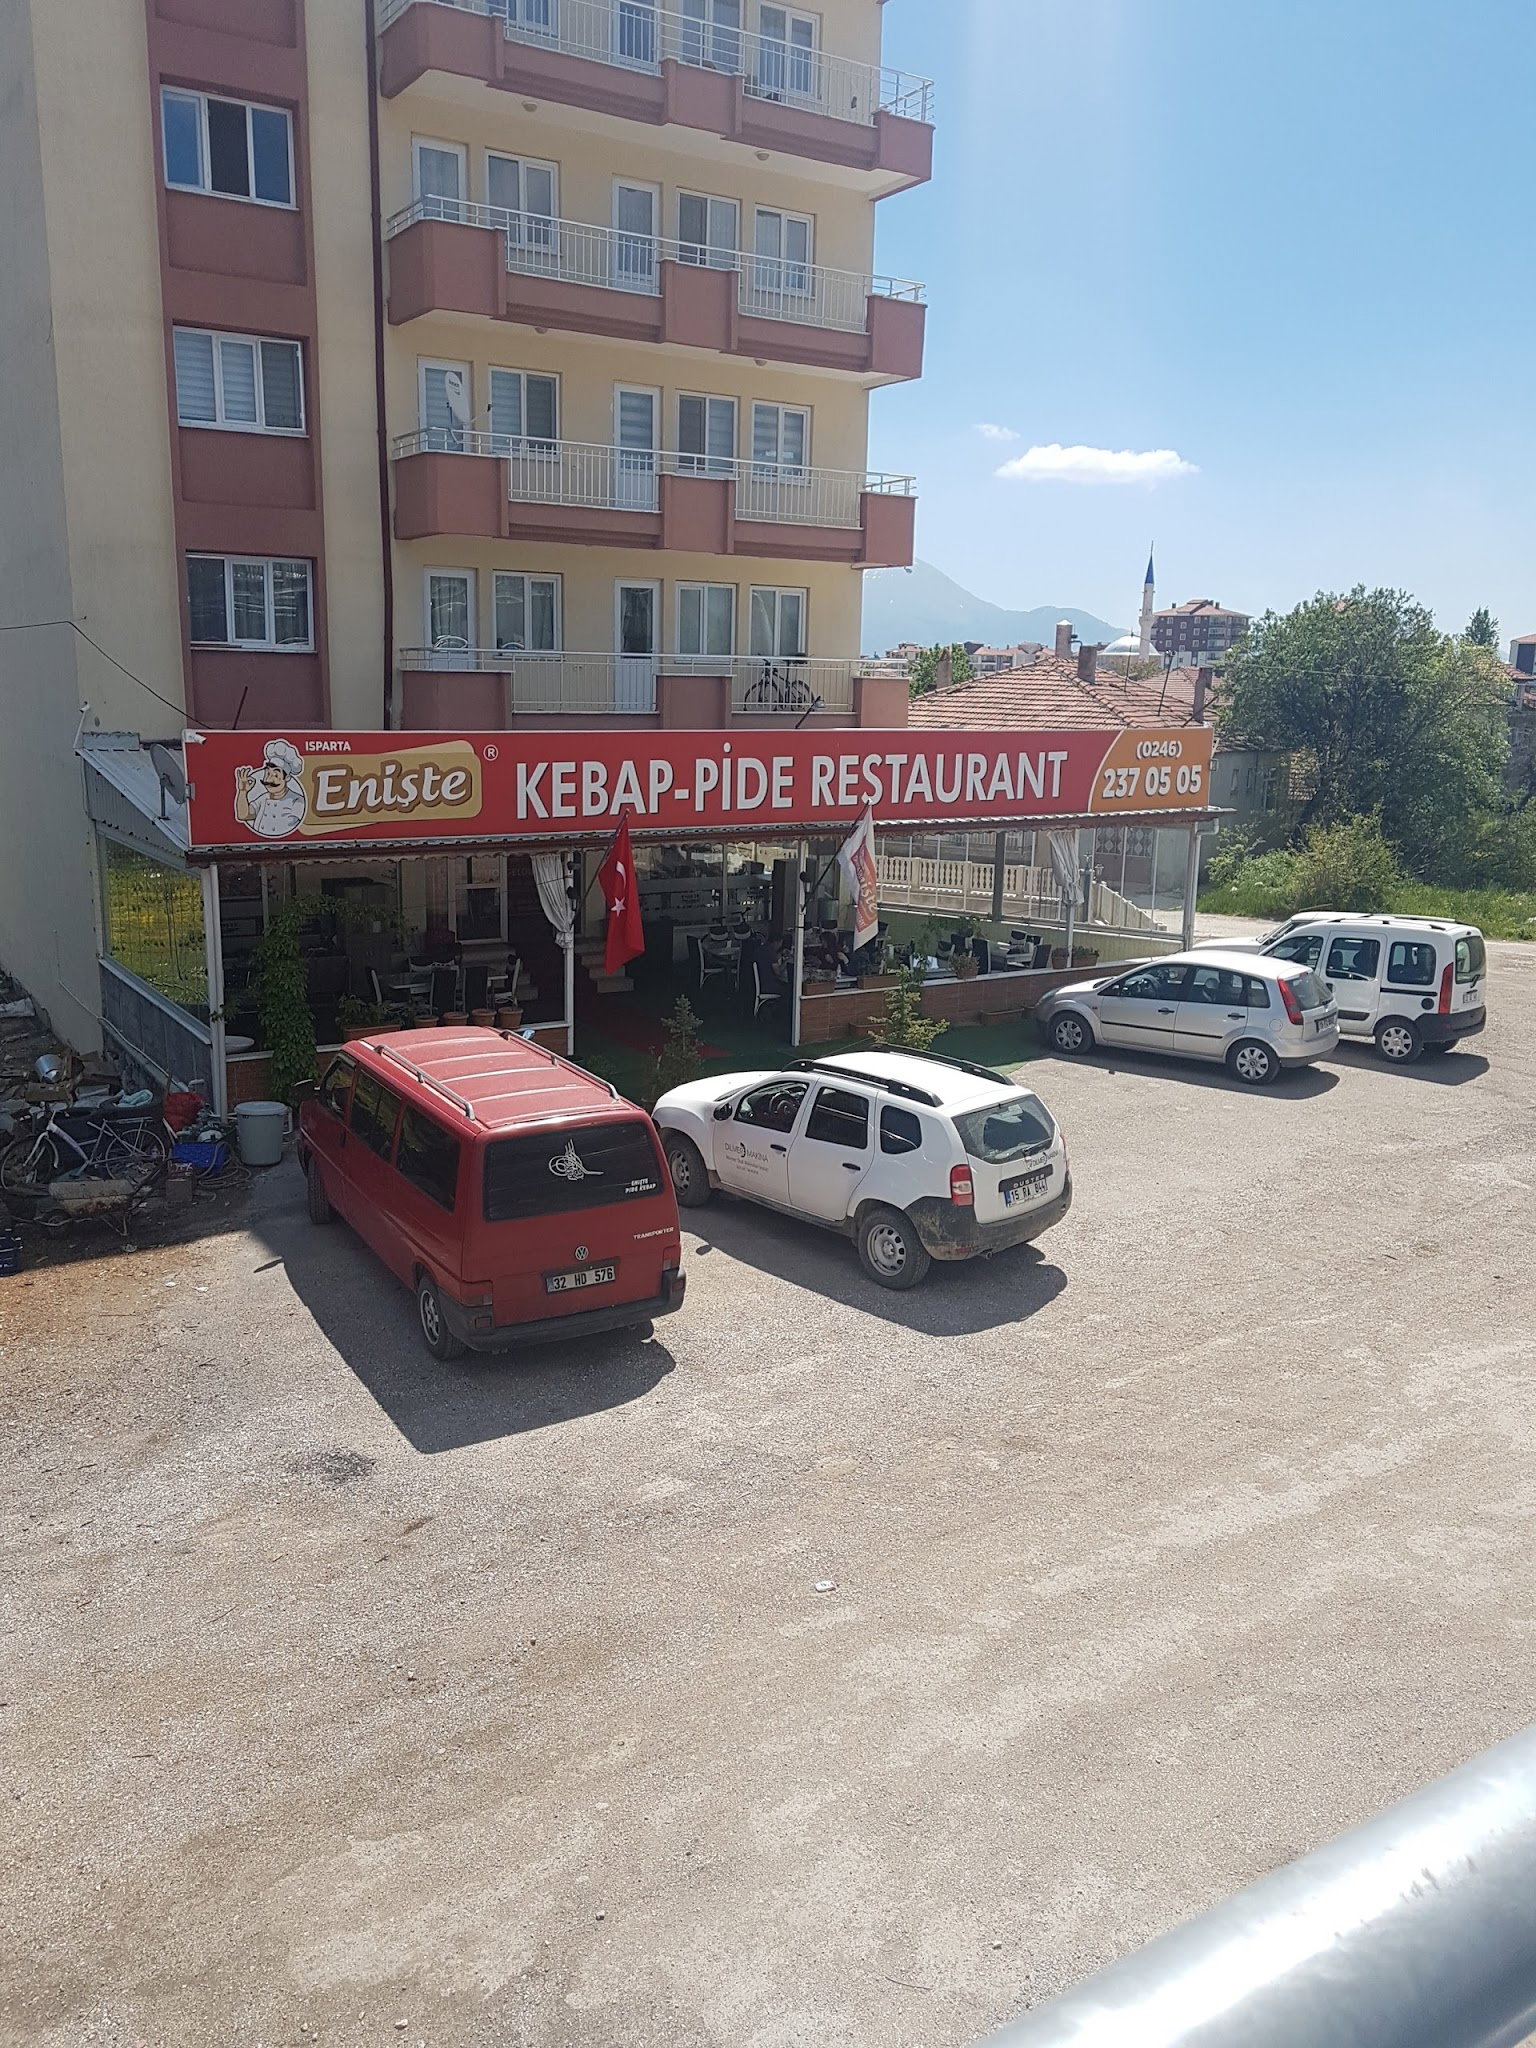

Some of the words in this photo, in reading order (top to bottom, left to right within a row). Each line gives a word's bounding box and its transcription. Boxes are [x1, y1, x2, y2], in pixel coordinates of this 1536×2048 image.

[304, 740, 351, 752] ISPARTA
[1136, 740, 1183, 760] (0246)
[314, 764, 467, 811] Enişte
[516, 741, 794, 819] KEBAP-PİDE
[811, 750, 1069, 807] RESTAURANT
[1102, 767, 1141, 798] 237
[1145, 766, 1172, 796] 05
[1176, 764, 1202, 794] 05
[1013, 1174, 1044, 1187] DUSTER
[1011, 1190, 1019, 1201] 15
[1022, 1187, 1030, 1197] RA
[634, 1227, 674, 1239] TRANSPORTER
[554, 1277, 567, 1289] 32
[575, 1273, 587, 1285] HD
[595, 1268, 612, 1281] 576
